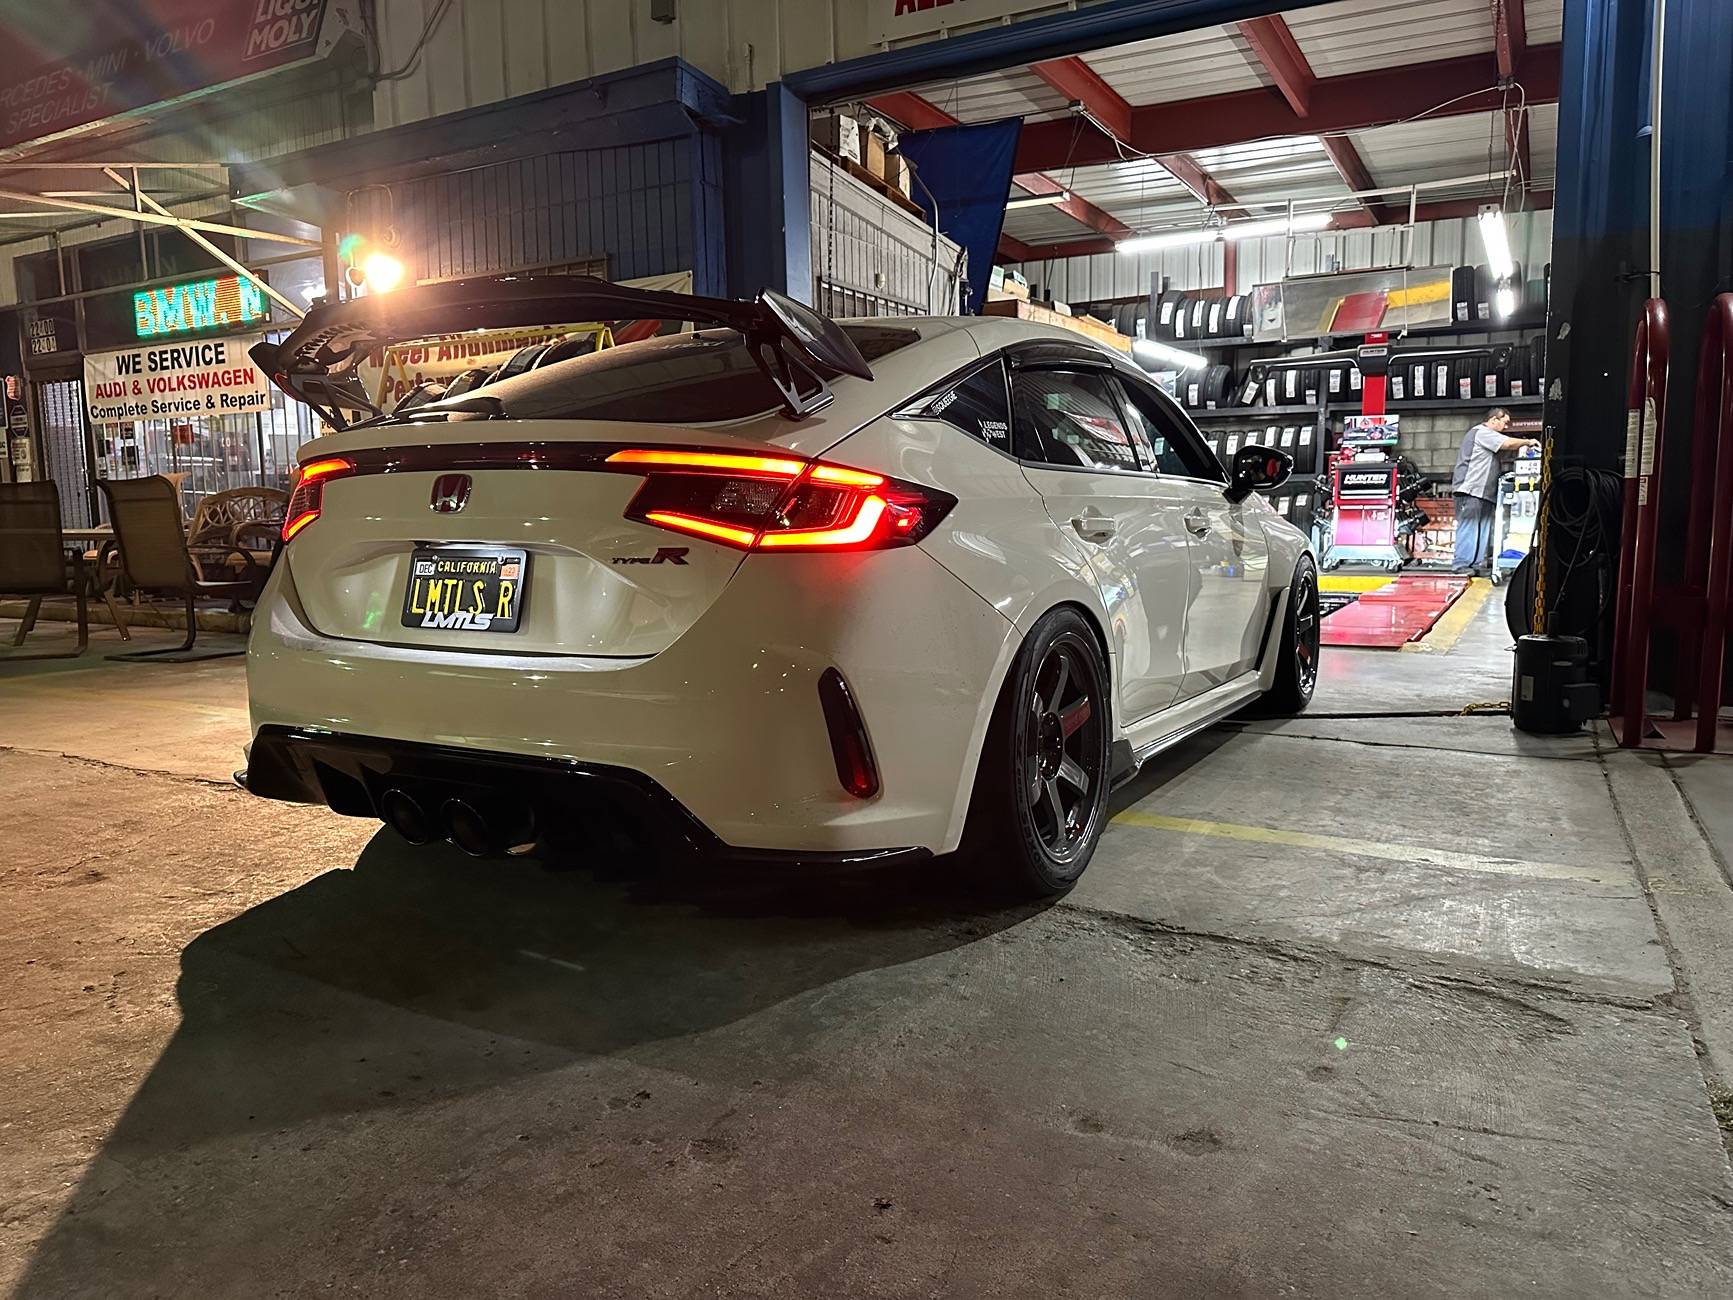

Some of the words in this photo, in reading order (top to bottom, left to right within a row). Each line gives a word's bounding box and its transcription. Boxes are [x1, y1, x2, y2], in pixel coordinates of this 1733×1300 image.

[247, 9, 318, 56] MOLY
[86, 49, 128, 81] MINI
[145, 18, 215, 61] VOLVO
[6, 81, 115, 135] SPECIALIST
[116, 354, 142, 375] WE
[148, 343, 226, 372] SERVICE
[95, 381, 127, 399] AUDI
[132, 380, 142, 396] &
[147, 368, 255, 394] VOLKSWAGEN
[90, 402, 148, 420] Complete
[151, 397, 201, 414] Service
[205, 394, 215, 409] &
[220, 391, 266, 410] Repair
[1345, 473, 1388, 482] HUNTER
[419, 563, 434, 574] DEC
[437, 560, 498, 575] CALIFORNIA
[612, 557, 651, 566] TYPE
[650, 546, 690, 566] R
[411, 578, 486, 615] LMTLS
[496, 581, 513, 618] R
